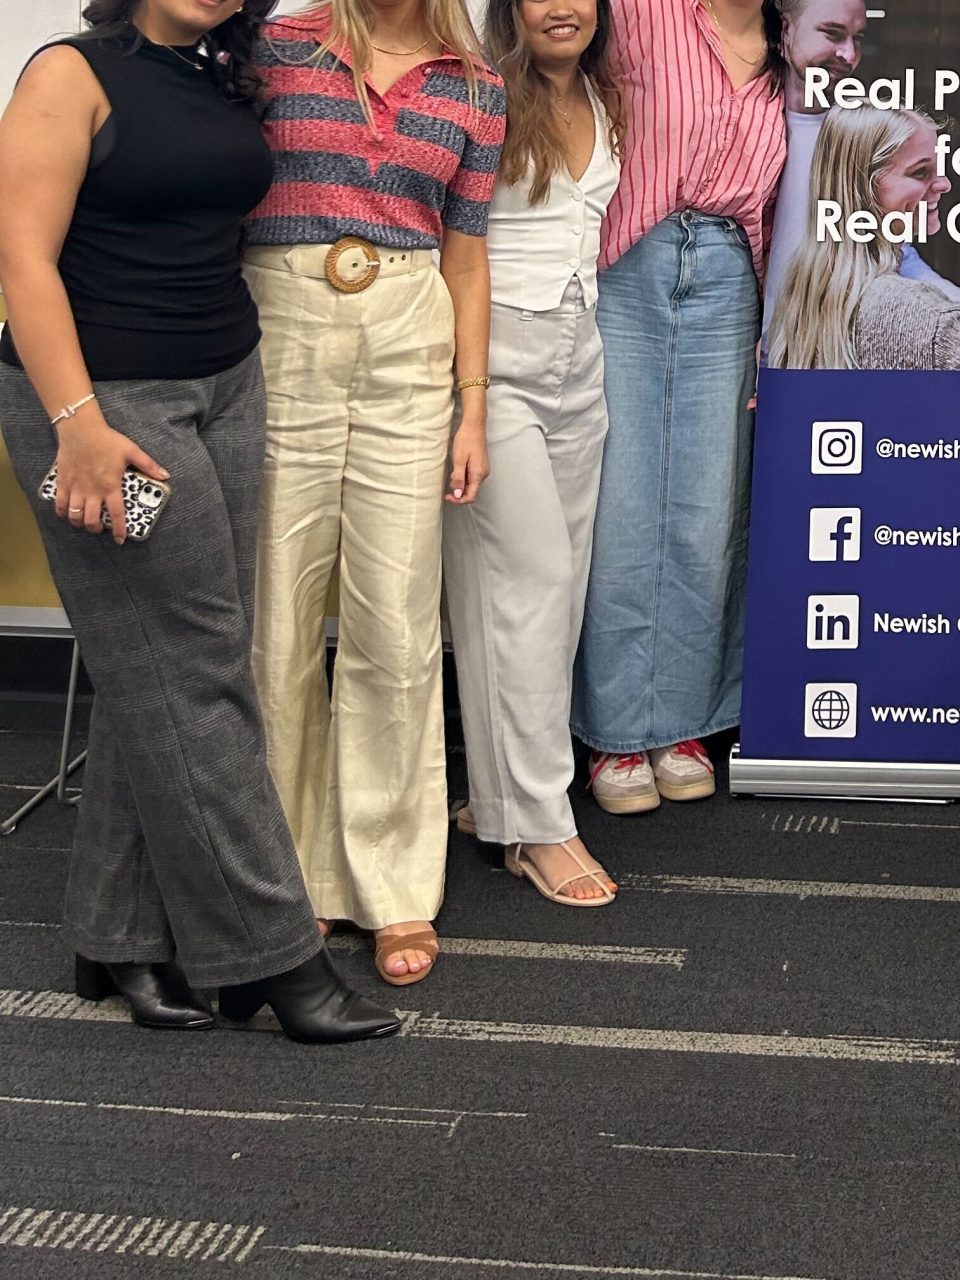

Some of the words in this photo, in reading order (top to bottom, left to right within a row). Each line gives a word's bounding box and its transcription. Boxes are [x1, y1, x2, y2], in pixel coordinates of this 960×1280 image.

[804, 67, 914, 110] Real
[816, 200, 928, 243] Real
[815, 604, 850, 641] in
[873, 613, 950, 634] Newish
